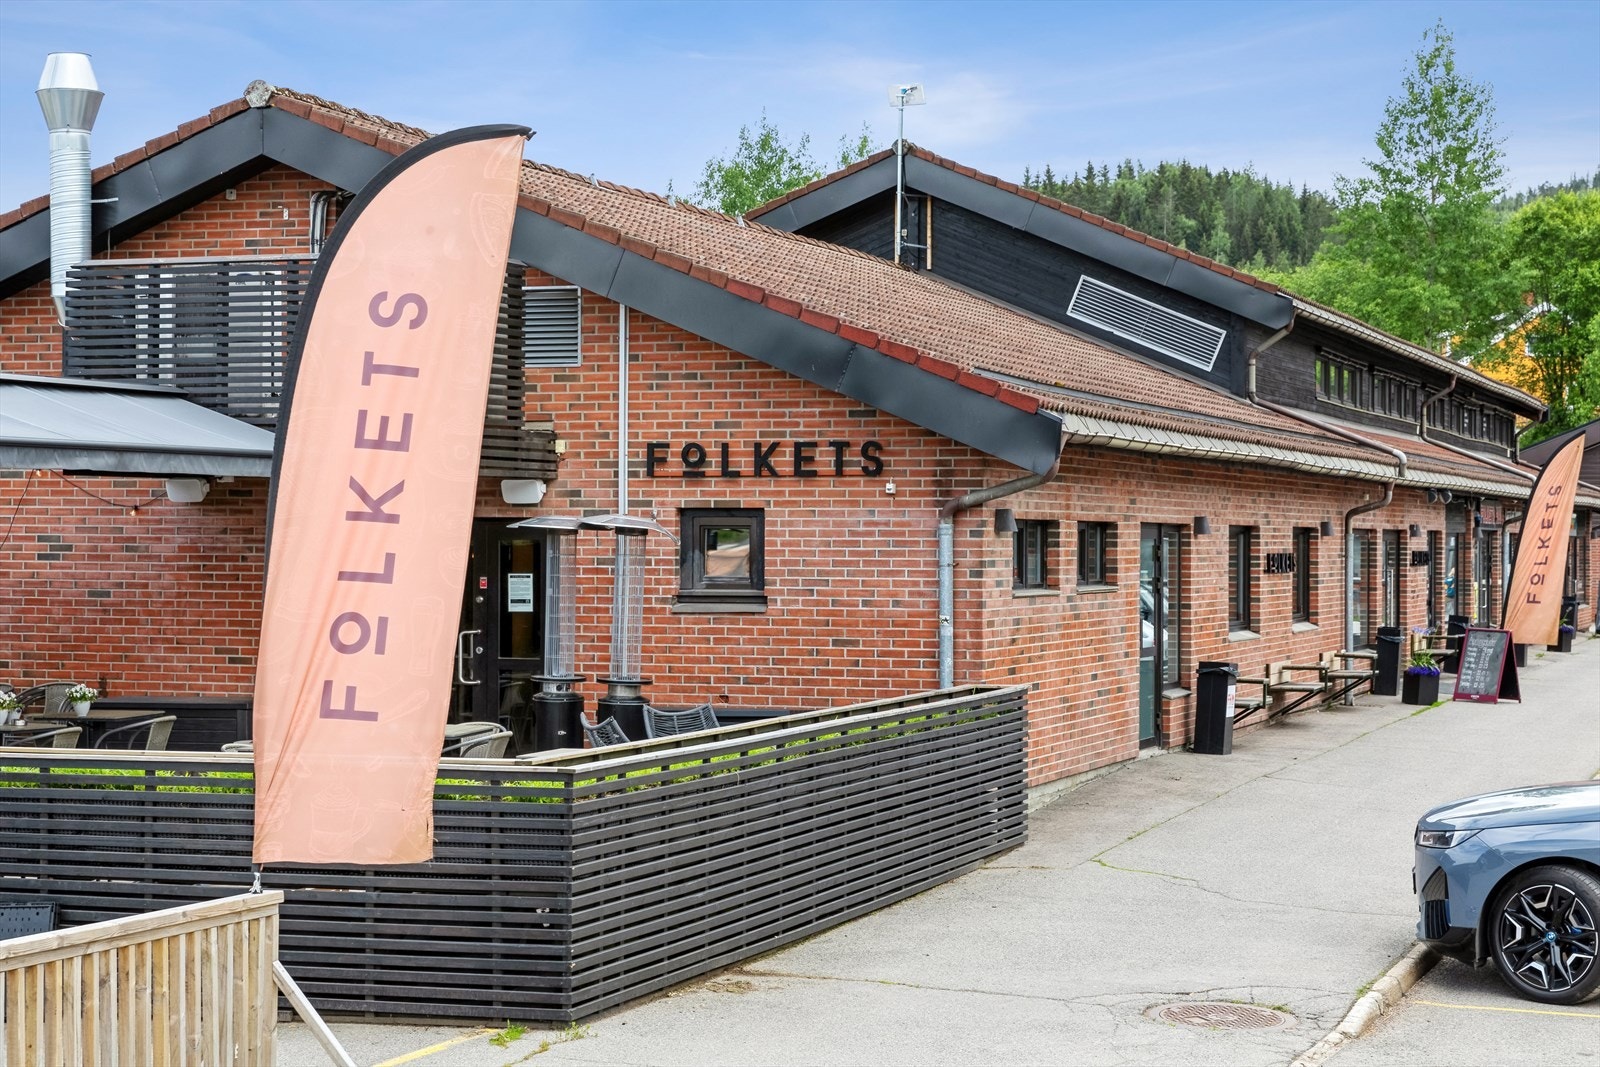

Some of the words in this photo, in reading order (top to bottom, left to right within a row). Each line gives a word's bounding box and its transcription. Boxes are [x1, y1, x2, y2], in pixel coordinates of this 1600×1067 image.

[319, 290, 429, 722] FOLKETS
[646, 441, 884, 478] FOLKETS
[1526, 485, 1562, 604] FOLKETS
